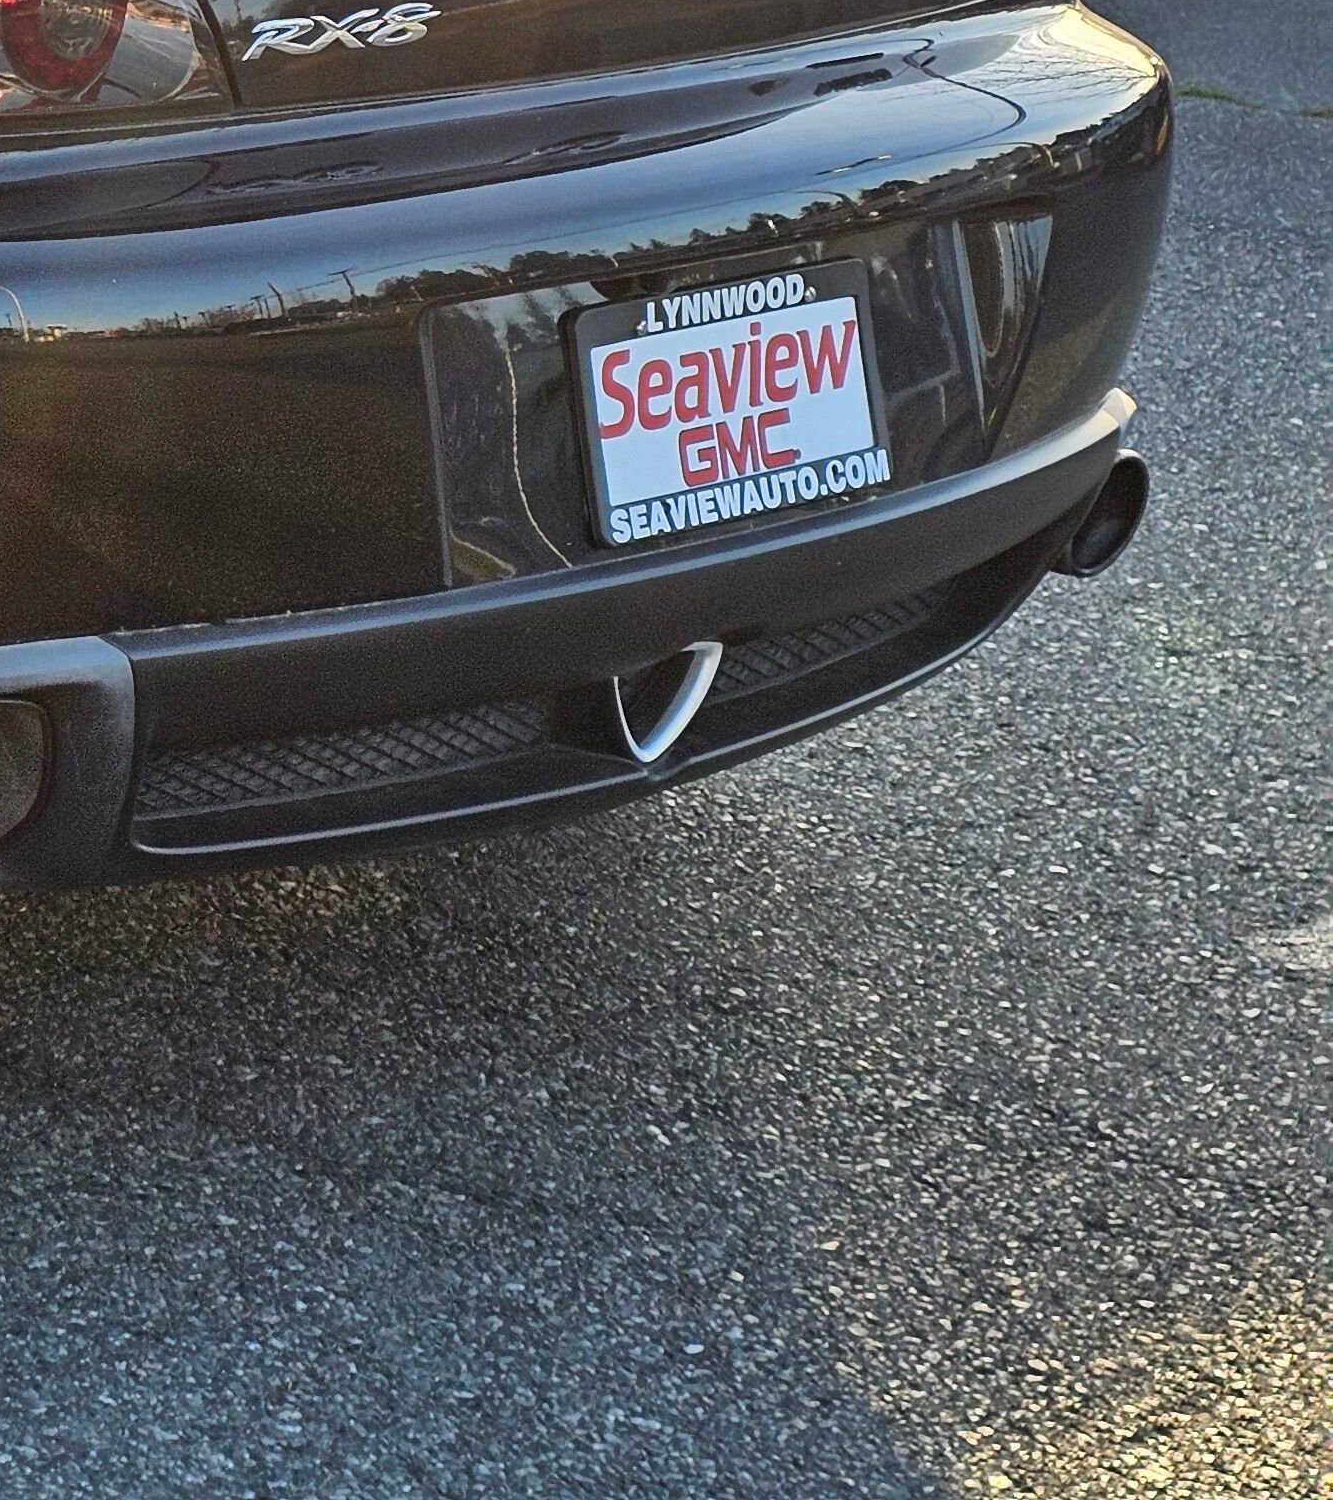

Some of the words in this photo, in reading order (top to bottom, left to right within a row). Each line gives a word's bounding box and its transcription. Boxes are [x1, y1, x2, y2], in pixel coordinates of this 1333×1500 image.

[646, 273, 806, 333] LYNNWOOD
[600, 319, 857, 440] Seaview
[678, 407, 798, 488] GMC
[609, 449, 891, 545] SEAVIEWAUTO.COM
